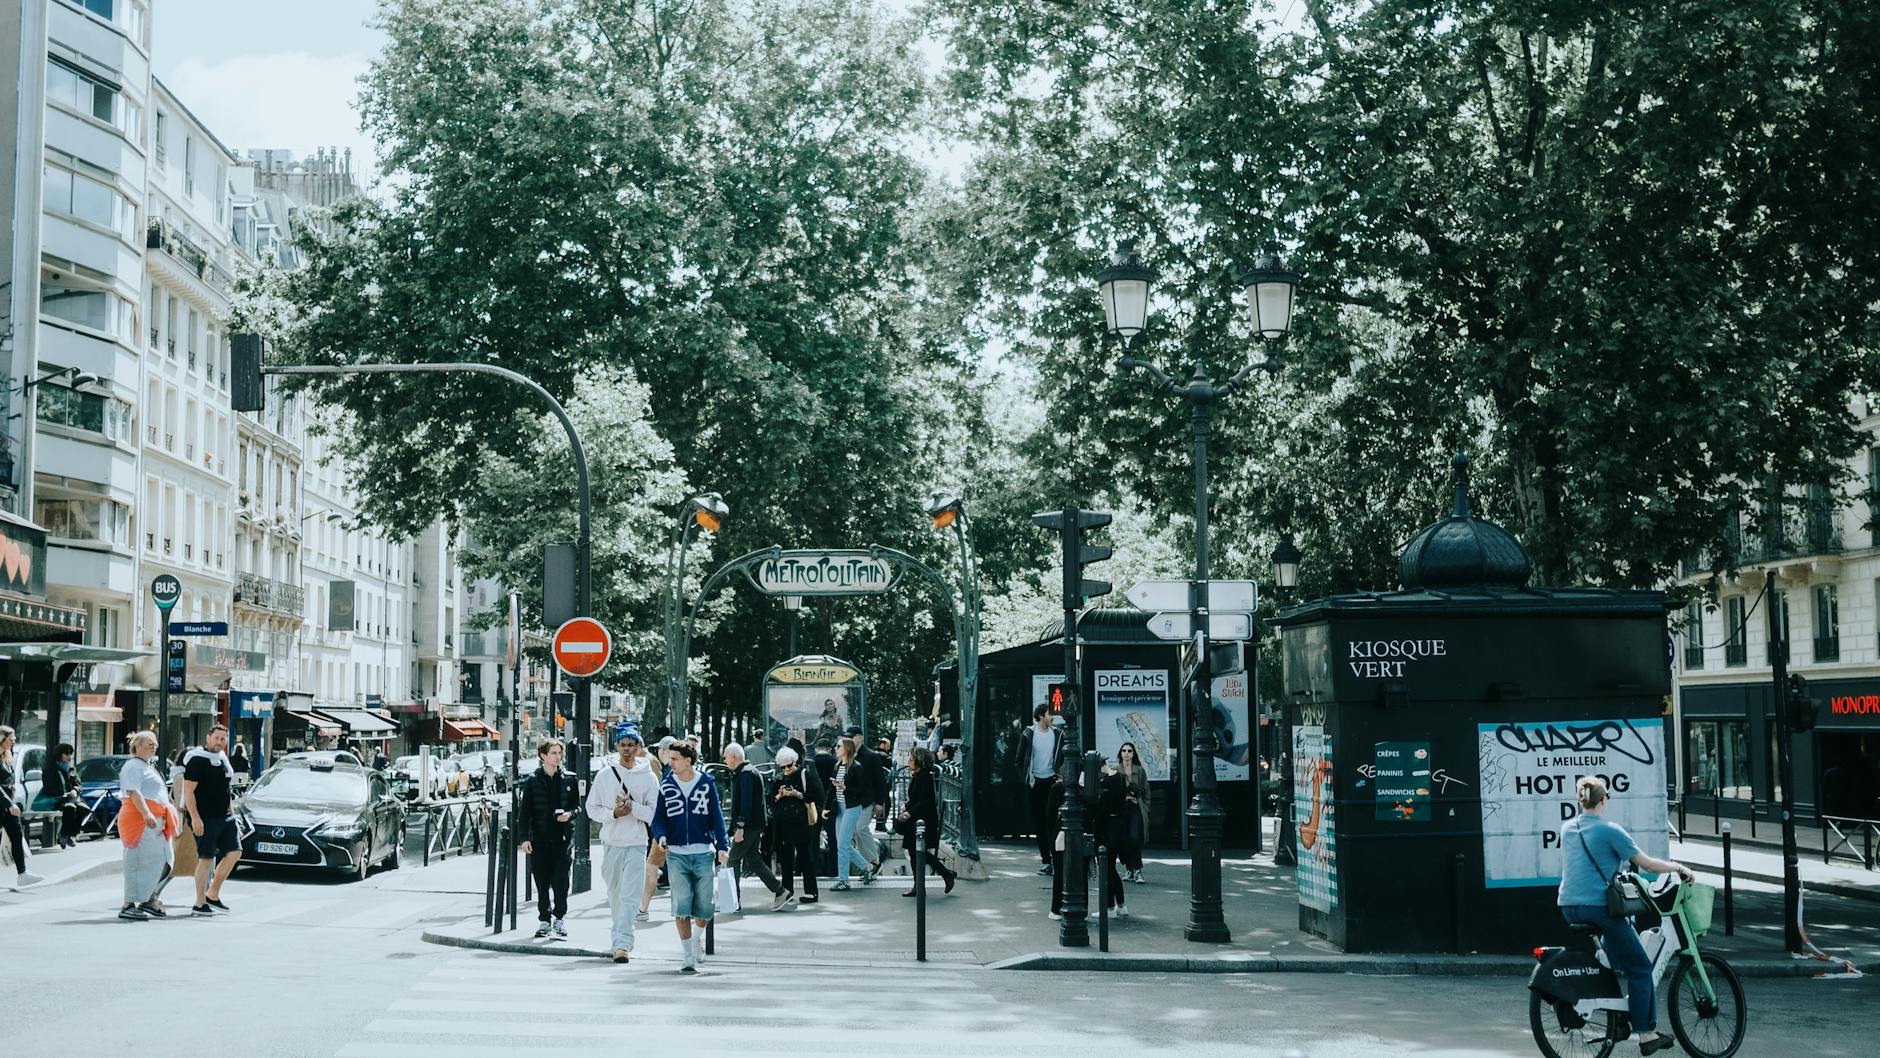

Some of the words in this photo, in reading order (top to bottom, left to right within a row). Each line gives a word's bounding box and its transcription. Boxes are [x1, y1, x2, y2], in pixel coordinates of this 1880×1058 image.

[765, 556, 886, 588] METROPOLITAIN
[155, 581, 177, 594] BUS
[184, 625, 212, 633] Blanche
[170, 641, 183, 650] 30
[1348, 639, 1447, 661] KIOSQUE
[793, 667, 837, 681] BLANCHE
[1350, 660, 1406, 679] VERT
[1098, 674, 1164, 687] DREAMS
[1100, 694, 1127, 704] Iconique
[1376, 750, 1400, 758] CRÊPES
[1537, 757, 1549, 767] LE
[1552, 756, 1606, 767] MEILLEUR
[1377, 769, 1404, 777] PANINIS
[1515, 775, 1566, 795] HOT
[1377, 788, 1416, 796] SANDWICHS
[1552, 968, 1564, 978] On
[1564, 967, 1581, 976] Lime
[1586, 966, 1600, 976] Uber
